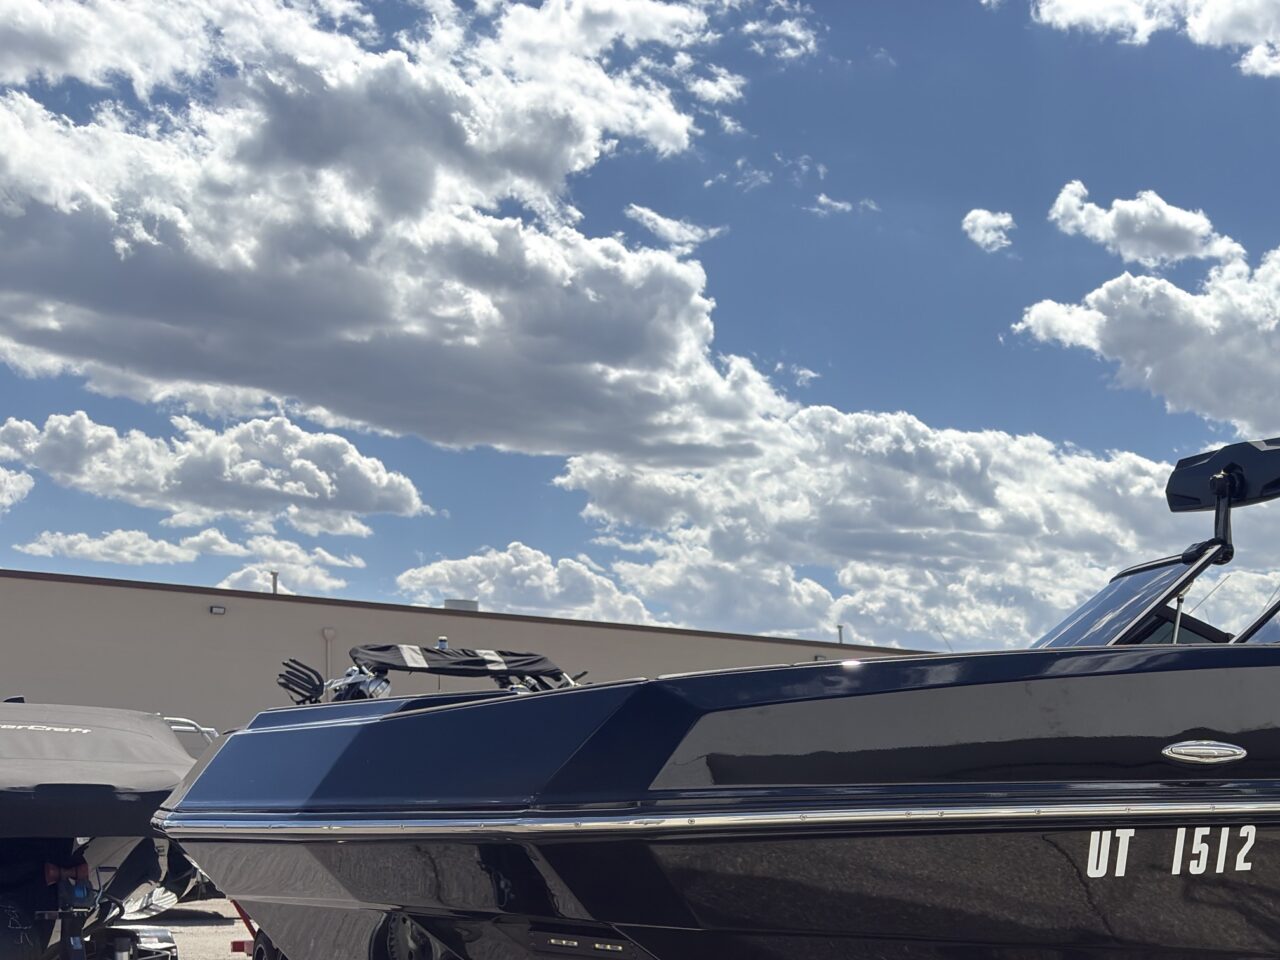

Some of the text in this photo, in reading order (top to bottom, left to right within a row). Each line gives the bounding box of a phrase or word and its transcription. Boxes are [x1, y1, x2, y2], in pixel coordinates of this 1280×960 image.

[0, 724, 92, 734] erCraft
[1086, 828, 1135, 878] UT
[1171, 824, 1257, 876] 1512
